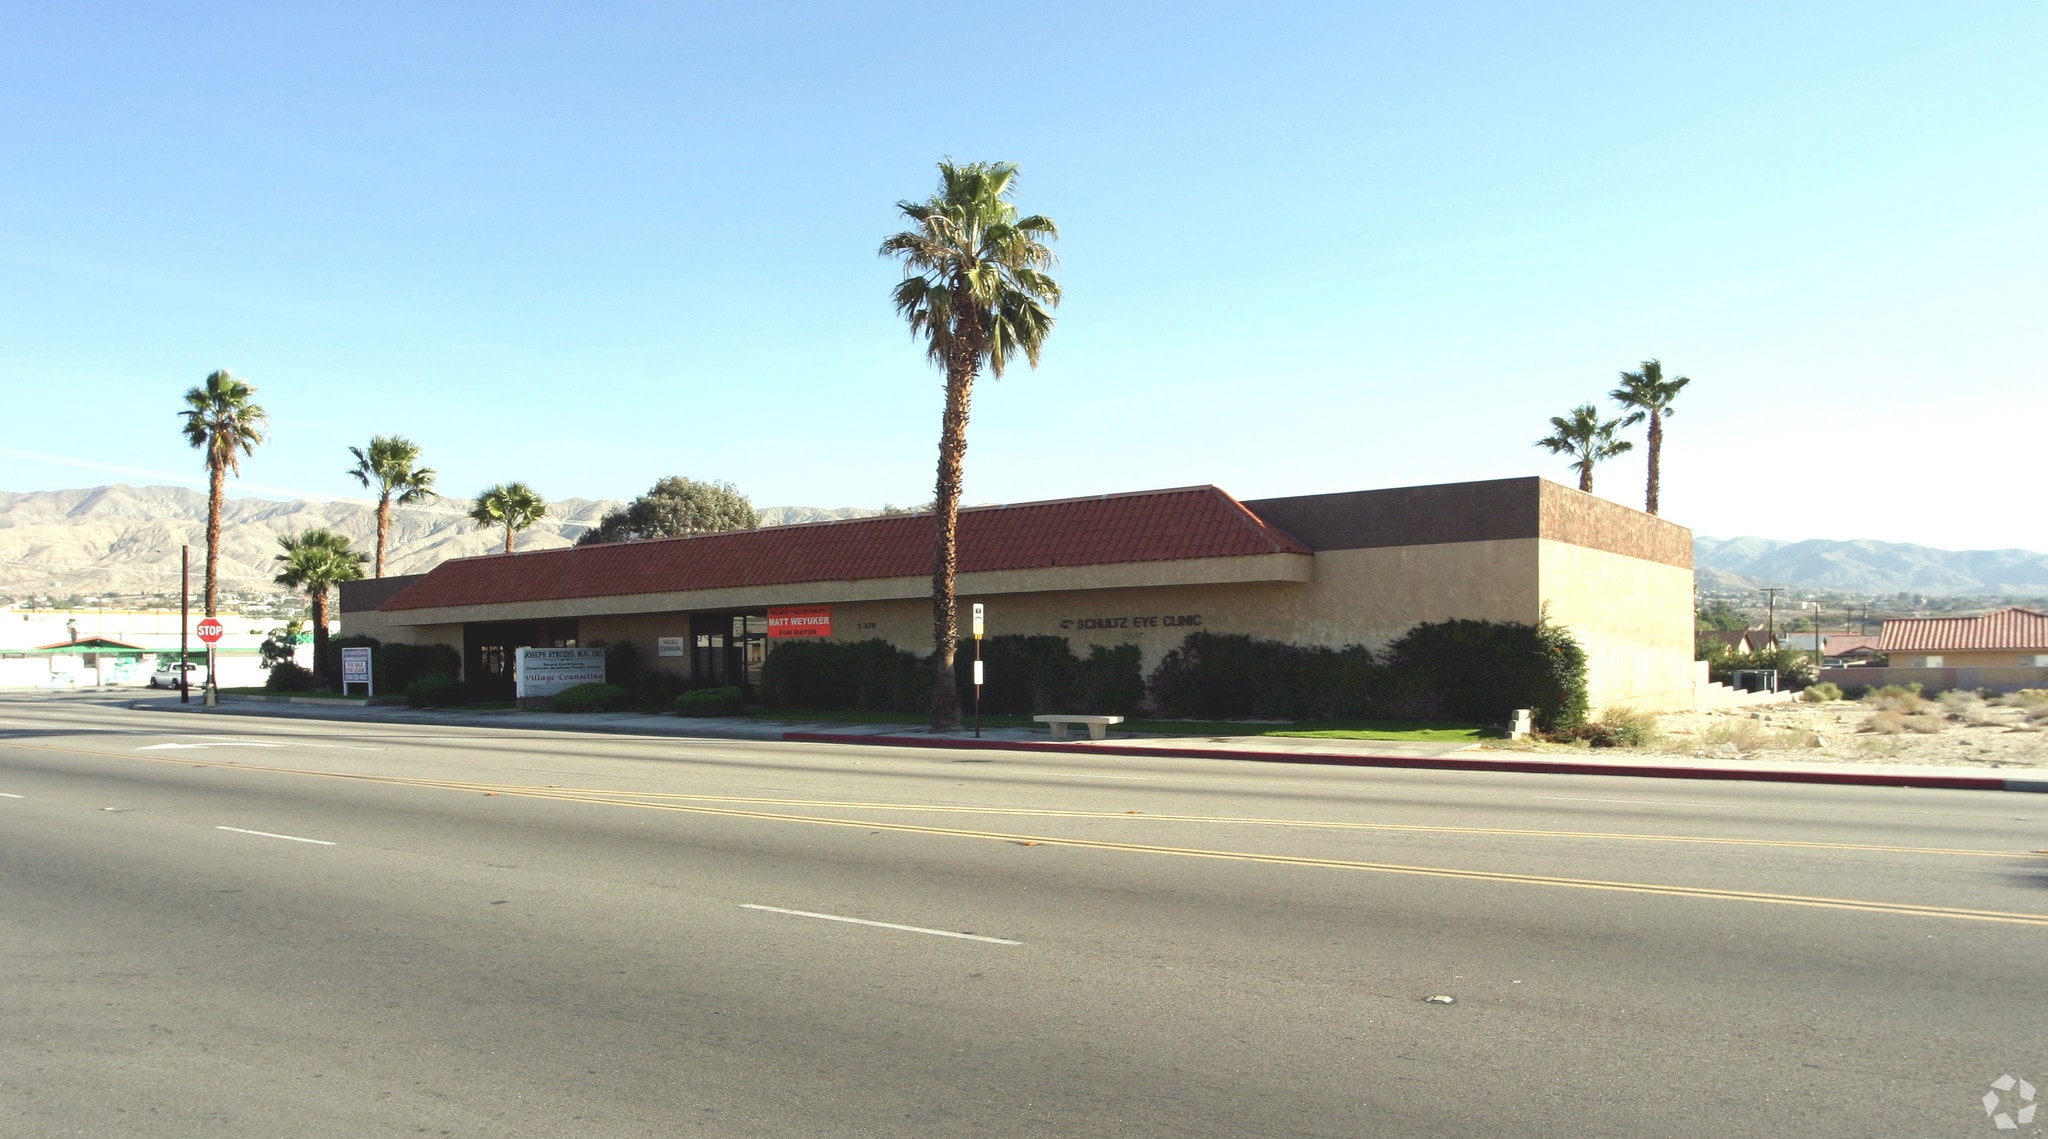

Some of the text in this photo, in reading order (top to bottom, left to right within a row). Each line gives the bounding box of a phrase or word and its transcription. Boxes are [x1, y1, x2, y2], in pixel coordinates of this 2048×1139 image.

[768, 616, 829, 626] MATT WEYUKER
[1077, 614, 1202, 630] SCHULTZ EYE CLINIC
[198, 625, 222, 636] STOP
[524, 650, 547, 659] JOSEPH
[525, 671, 604, 684] Village Counseling
